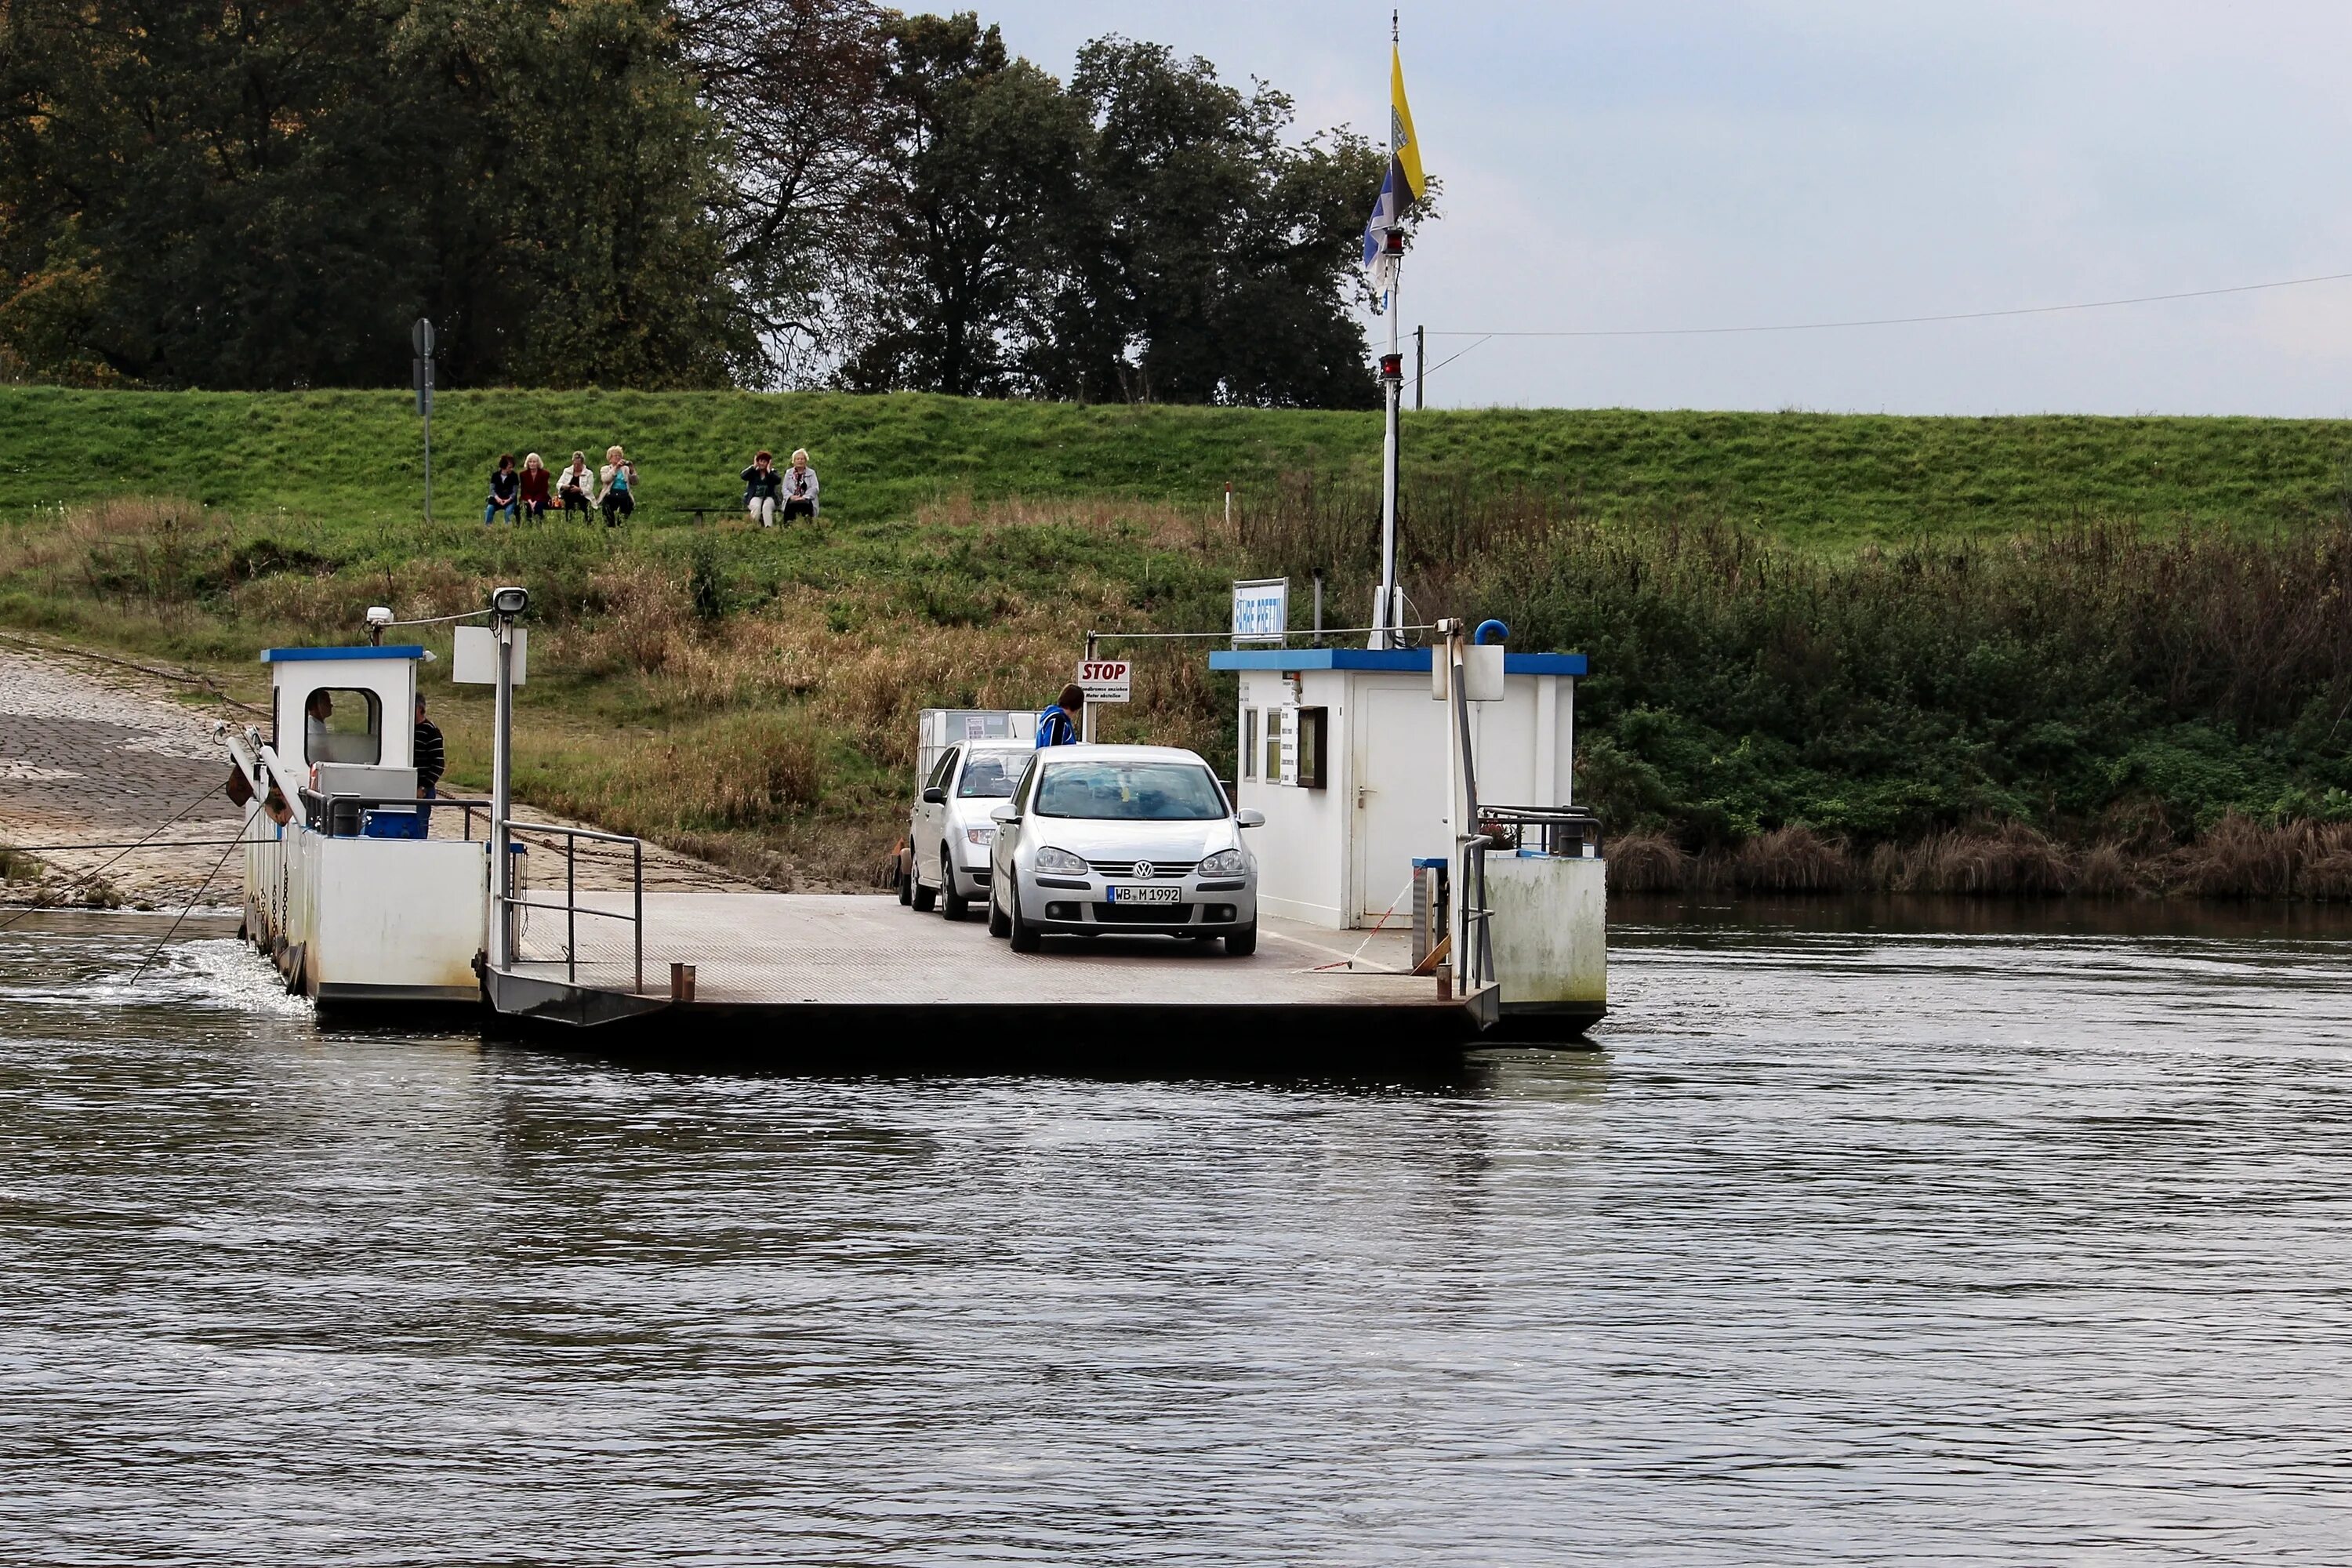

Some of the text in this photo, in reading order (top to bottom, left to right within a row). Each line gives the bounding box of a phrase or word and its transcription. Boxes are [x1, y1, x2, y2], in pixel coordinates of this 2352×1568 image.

[1256, 597, 1283, 633] PRETTIN
[1082, 663, 1126, 680] STOP
[1116, 888, 1131, 900] WB
